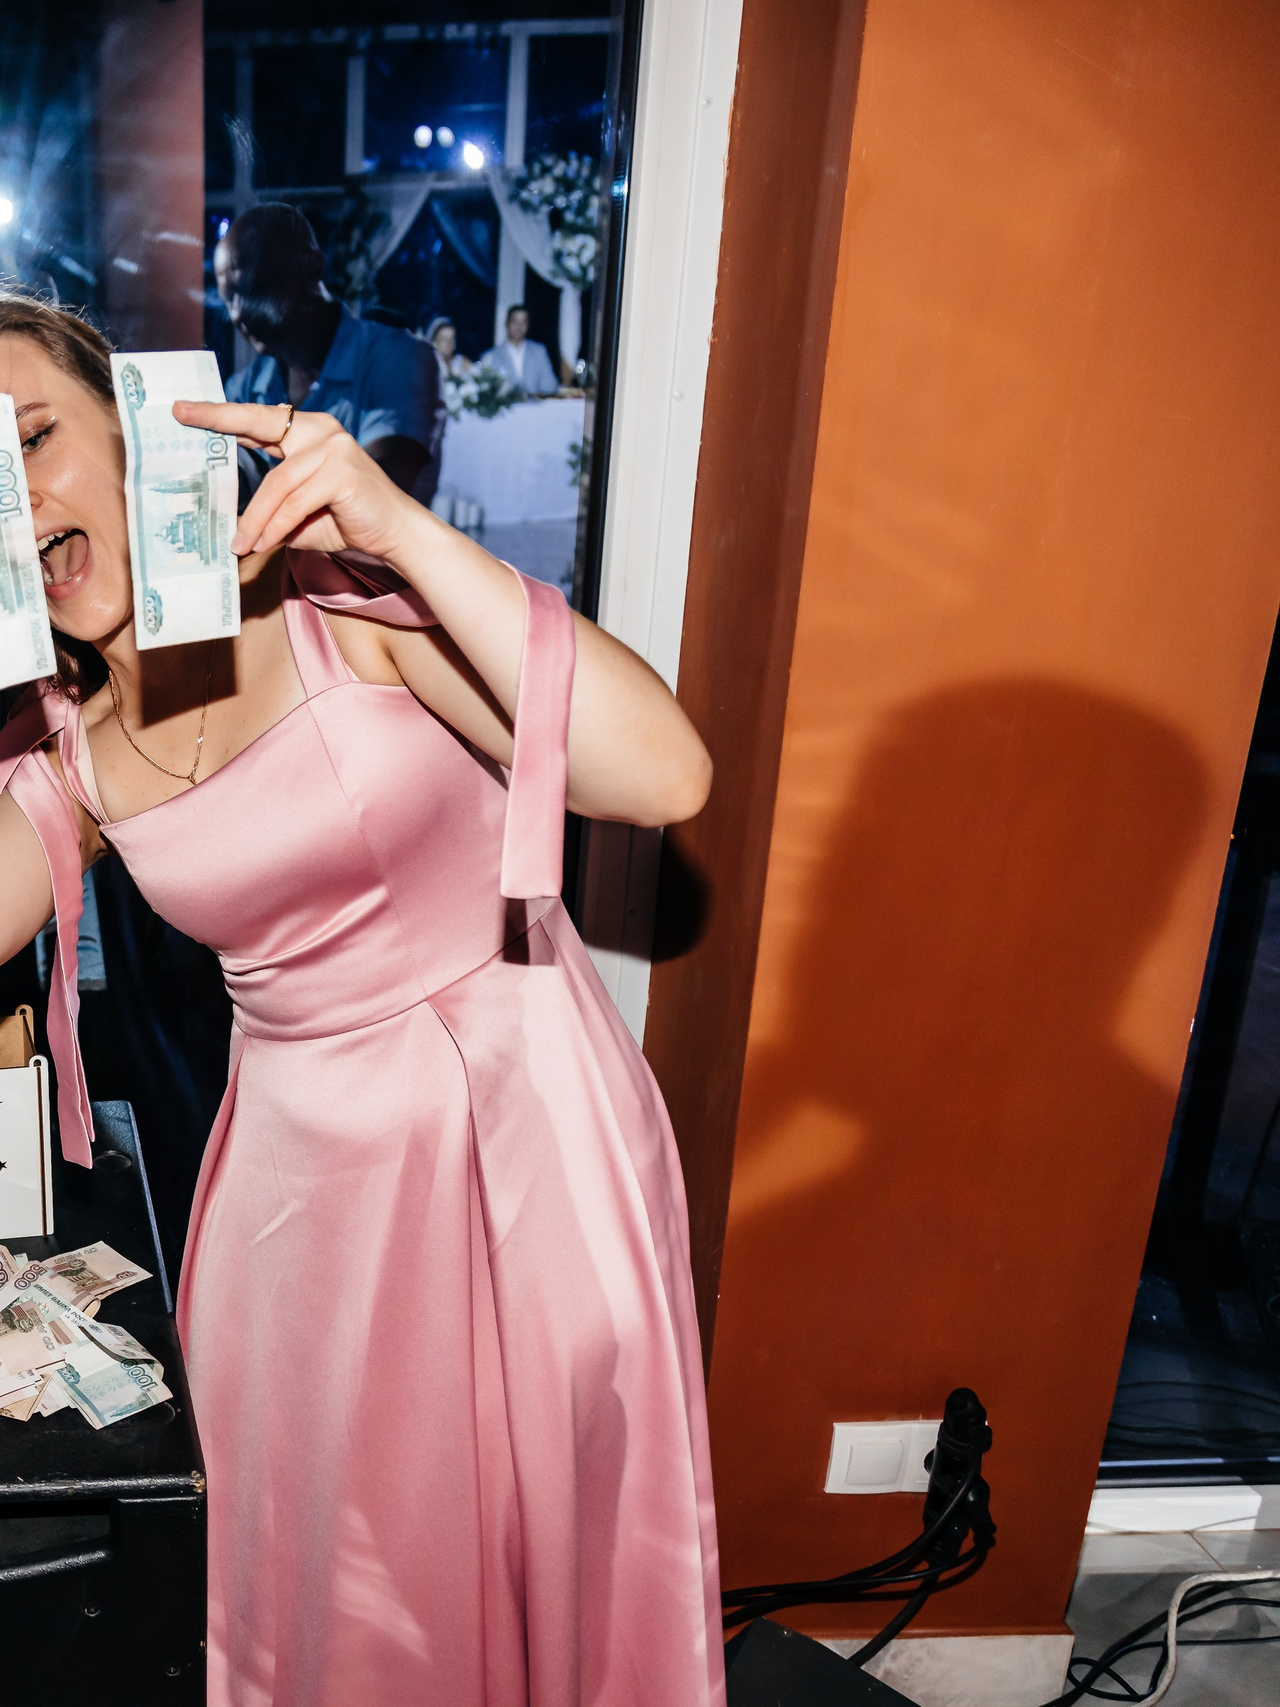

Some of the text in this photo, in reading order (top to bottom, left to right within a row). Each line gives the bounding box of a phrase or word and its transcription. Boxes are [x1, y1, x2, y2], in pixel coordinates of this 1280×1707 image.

[122, 370, 138, 403] 1000
[144, 596, 156, 628] 1000
[14, 1263, 48, 1290] 500
[121, 1359, 158, 1393] 1000
